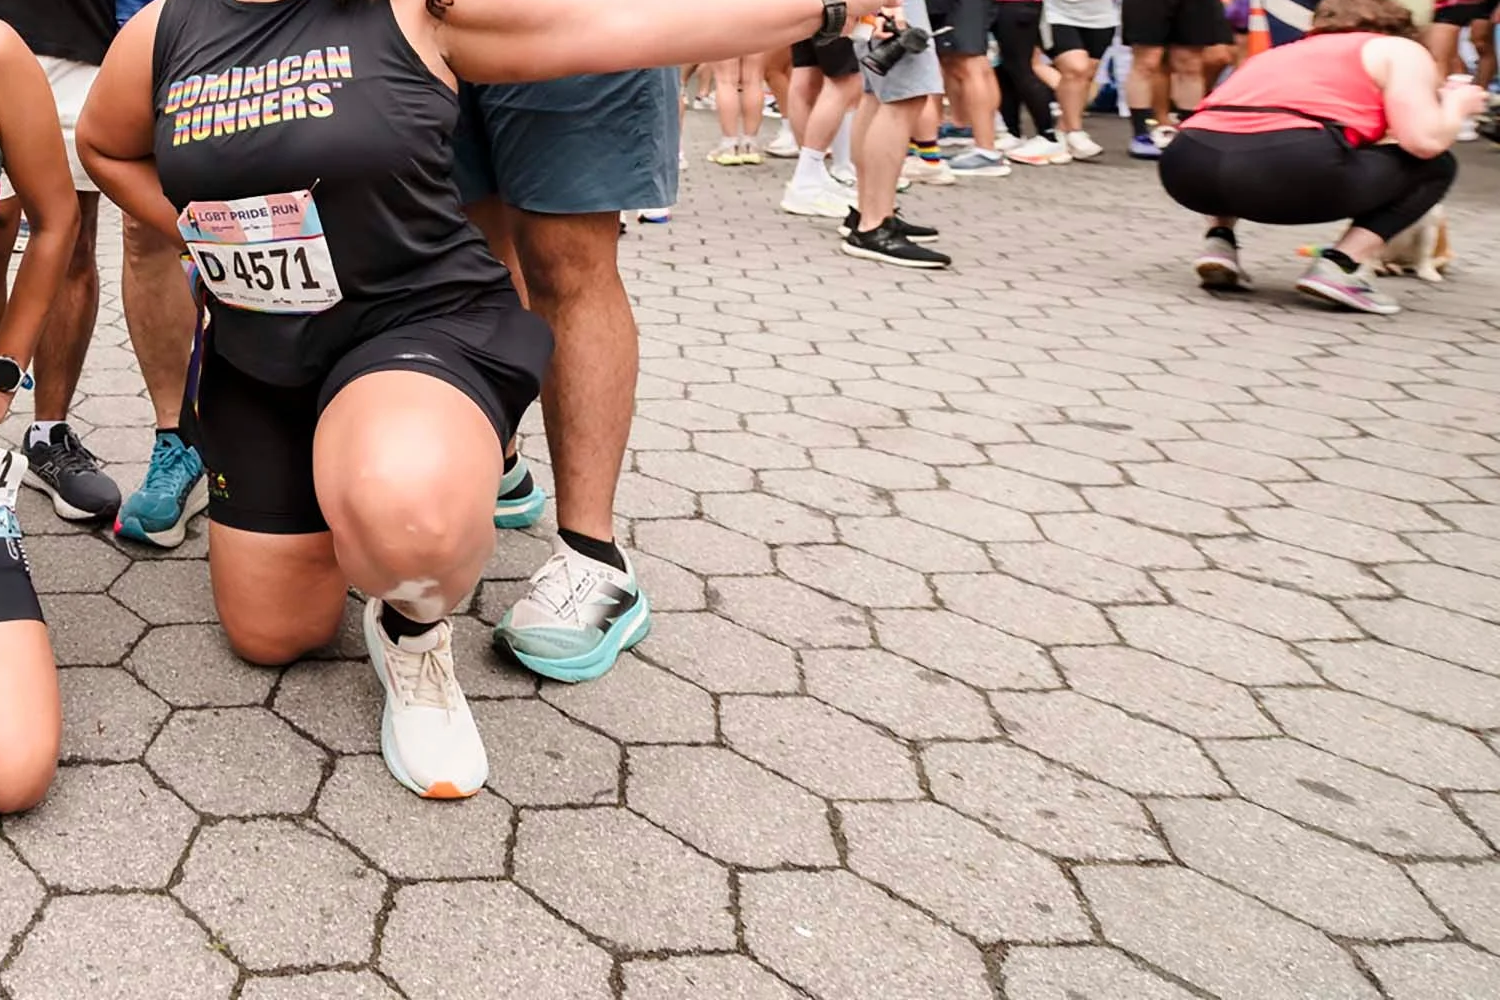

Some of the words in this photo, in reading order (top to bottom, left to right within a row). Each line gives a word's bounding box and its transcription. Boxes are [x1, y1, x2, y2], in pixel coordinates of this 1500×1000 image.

[164, 46, 353, 114] DOMINICAN
[198, 212, 227, 222] LGBT
[230, 207, 269, 221] PRIDE
[271, 204, 299, 216] RUN
[198, 250, 226, 282] D
[233, 246, 321, 291] 4571
